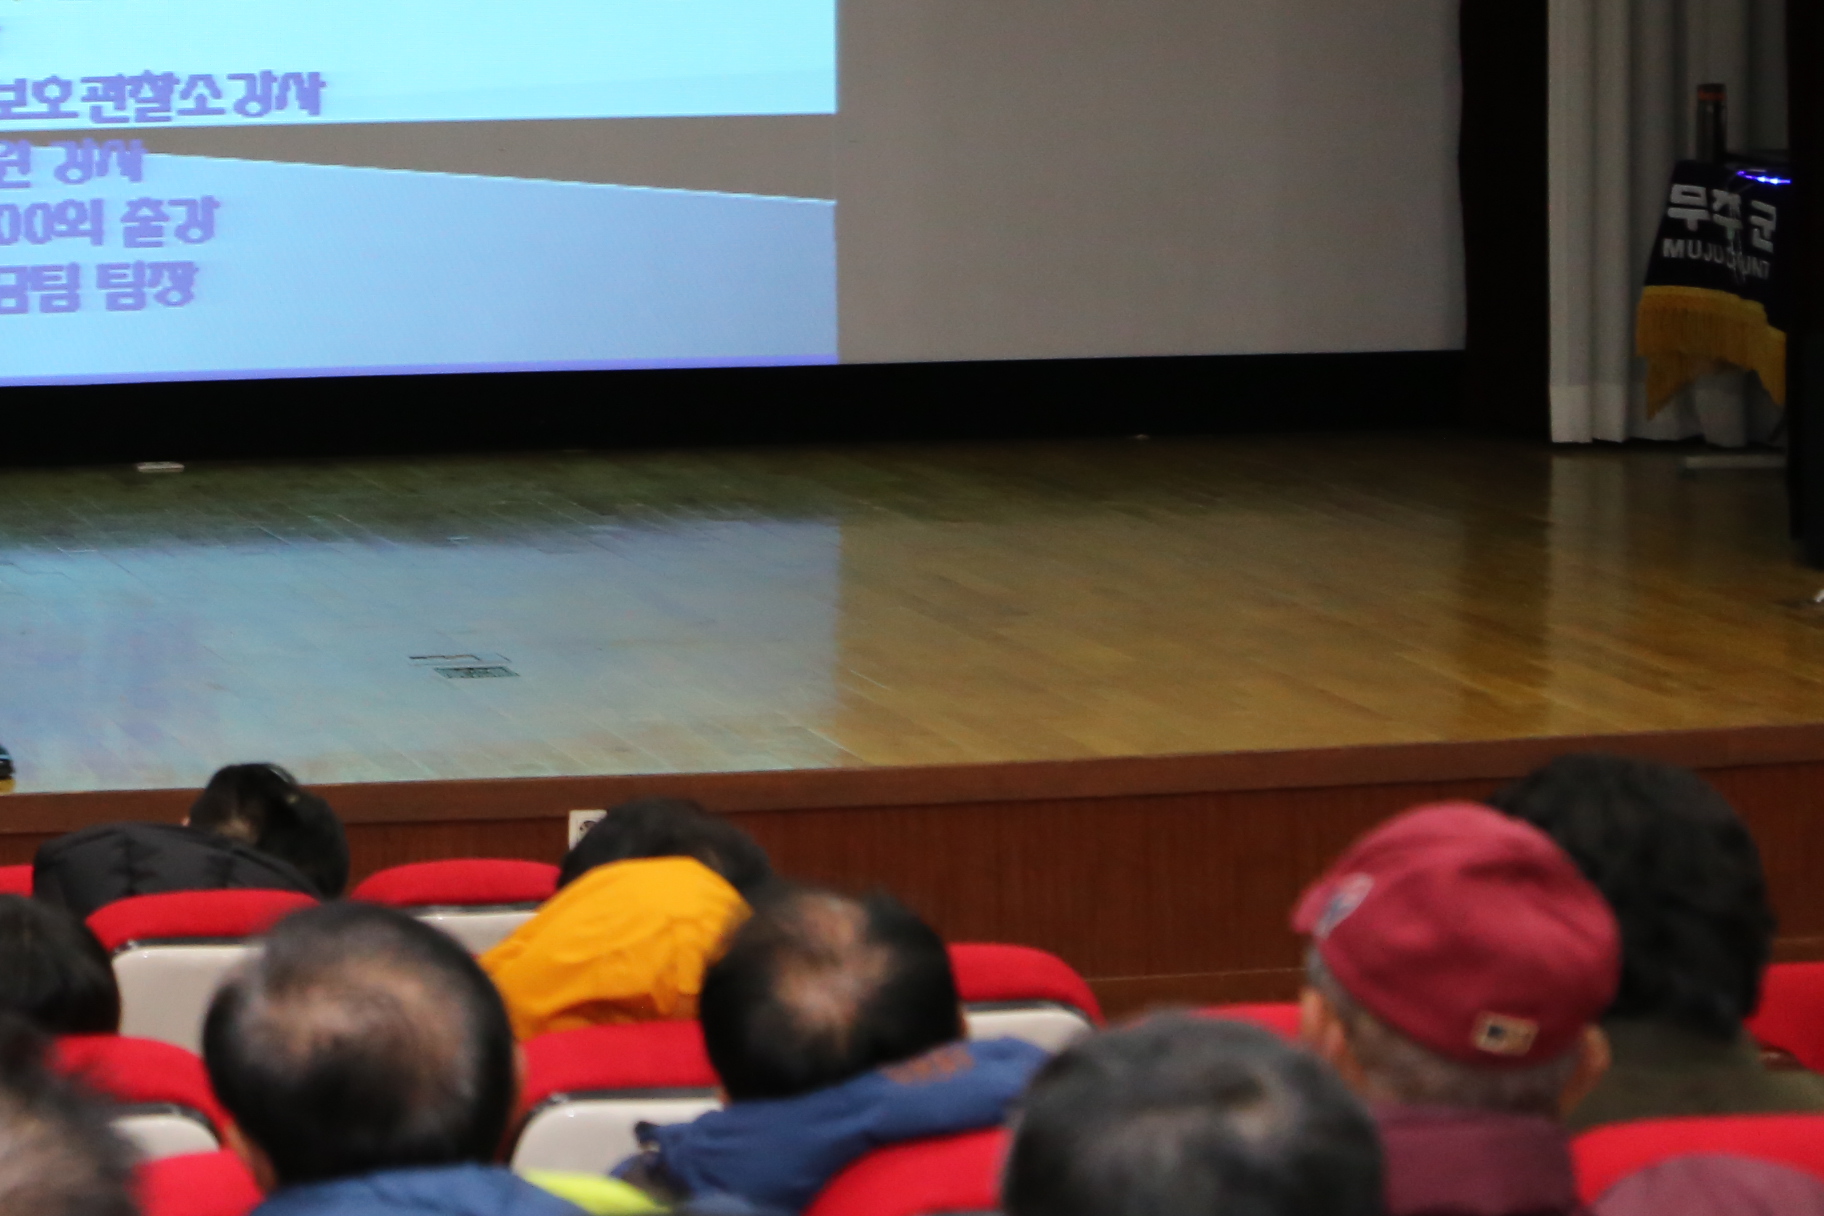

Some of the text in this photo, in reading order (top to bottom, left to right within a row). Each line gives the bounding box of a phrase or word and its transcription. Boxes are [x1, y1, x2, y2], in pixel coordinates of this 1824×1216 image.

[48, 138, 148, 184] 강사
[120, 195, 221, 248] 출강
[1667, 183, 1777, 254] 무주군
[96, 259, 199, 312] 팀장
